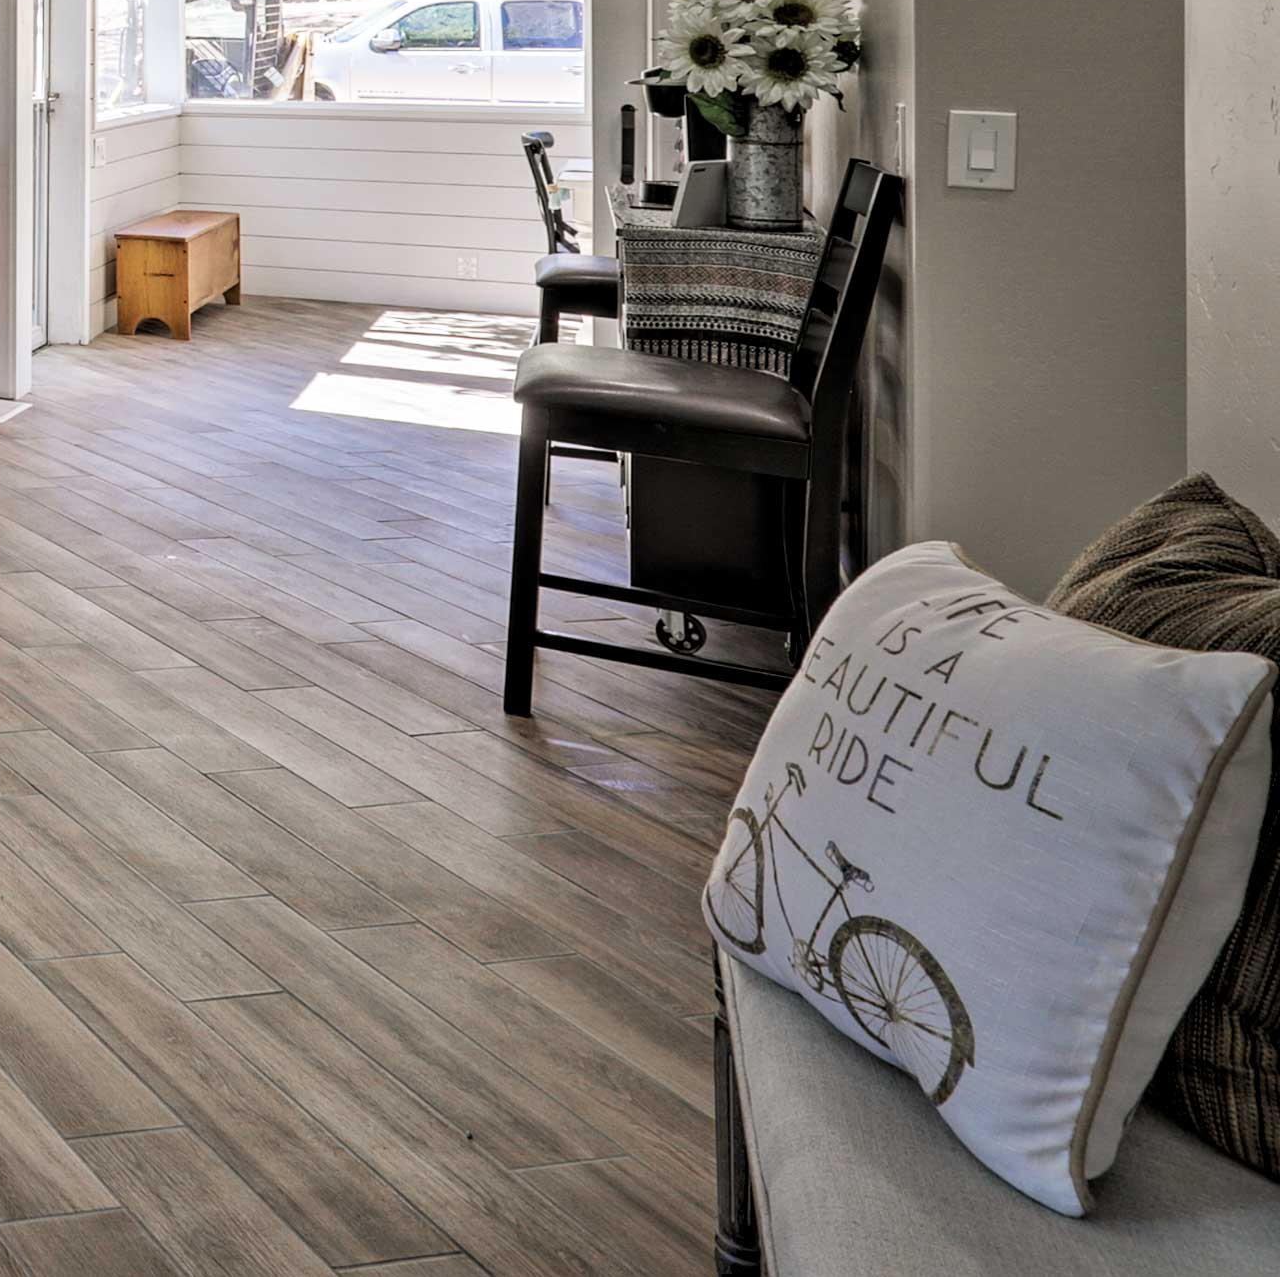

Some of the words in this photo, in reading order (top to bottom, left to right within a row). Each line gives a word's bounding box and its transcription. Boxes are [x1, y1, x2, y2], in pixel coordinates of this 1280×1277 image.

[876, 620, 922, 655] IS
[924, 650, 964, 684] A
[804, 636, 1064, 820] EAUTIFUL
[808, 712, 913, 814] RIDE
